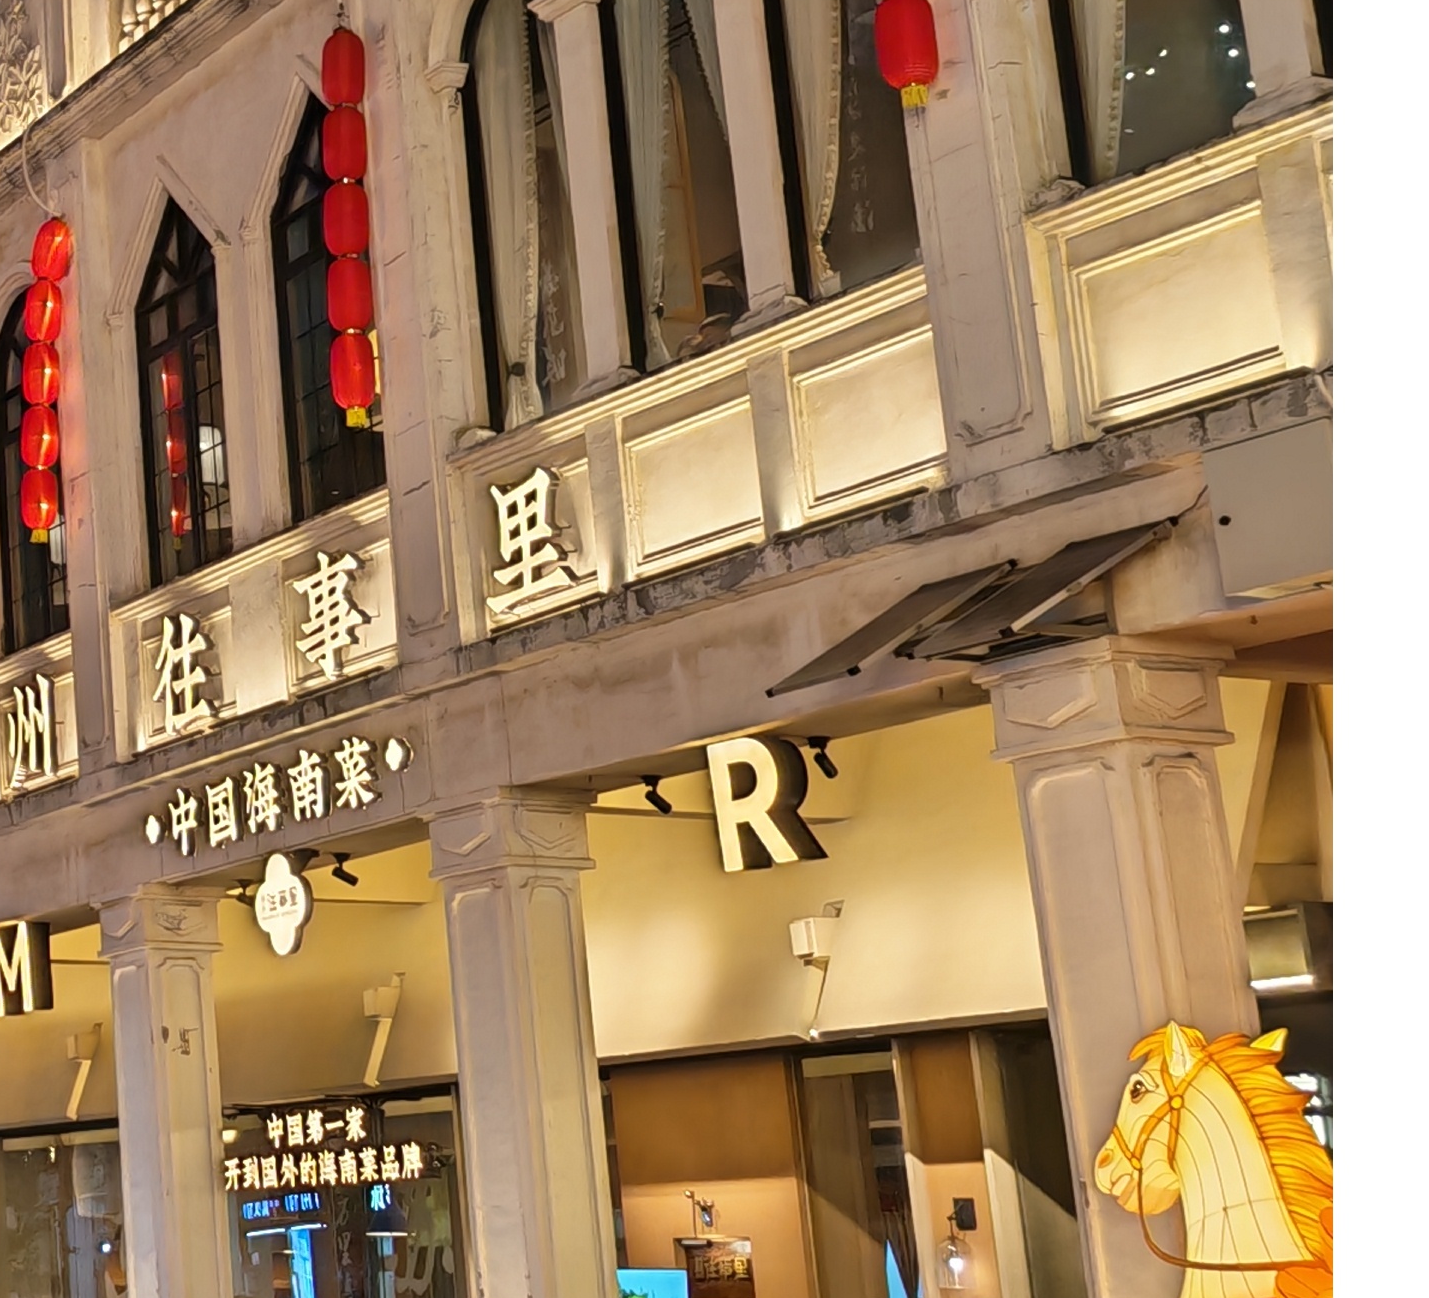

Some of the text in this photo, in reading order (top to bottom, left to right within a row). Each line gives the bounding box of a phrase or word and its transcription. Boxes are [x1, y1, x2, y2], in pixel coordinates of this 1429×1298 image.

[168, 737, 375, 856] 中国海南菜
[266, 1106, 367, 1149] 中国第一家
[224, 1141, 424, 1191] 开到国外的海南菜品牌
